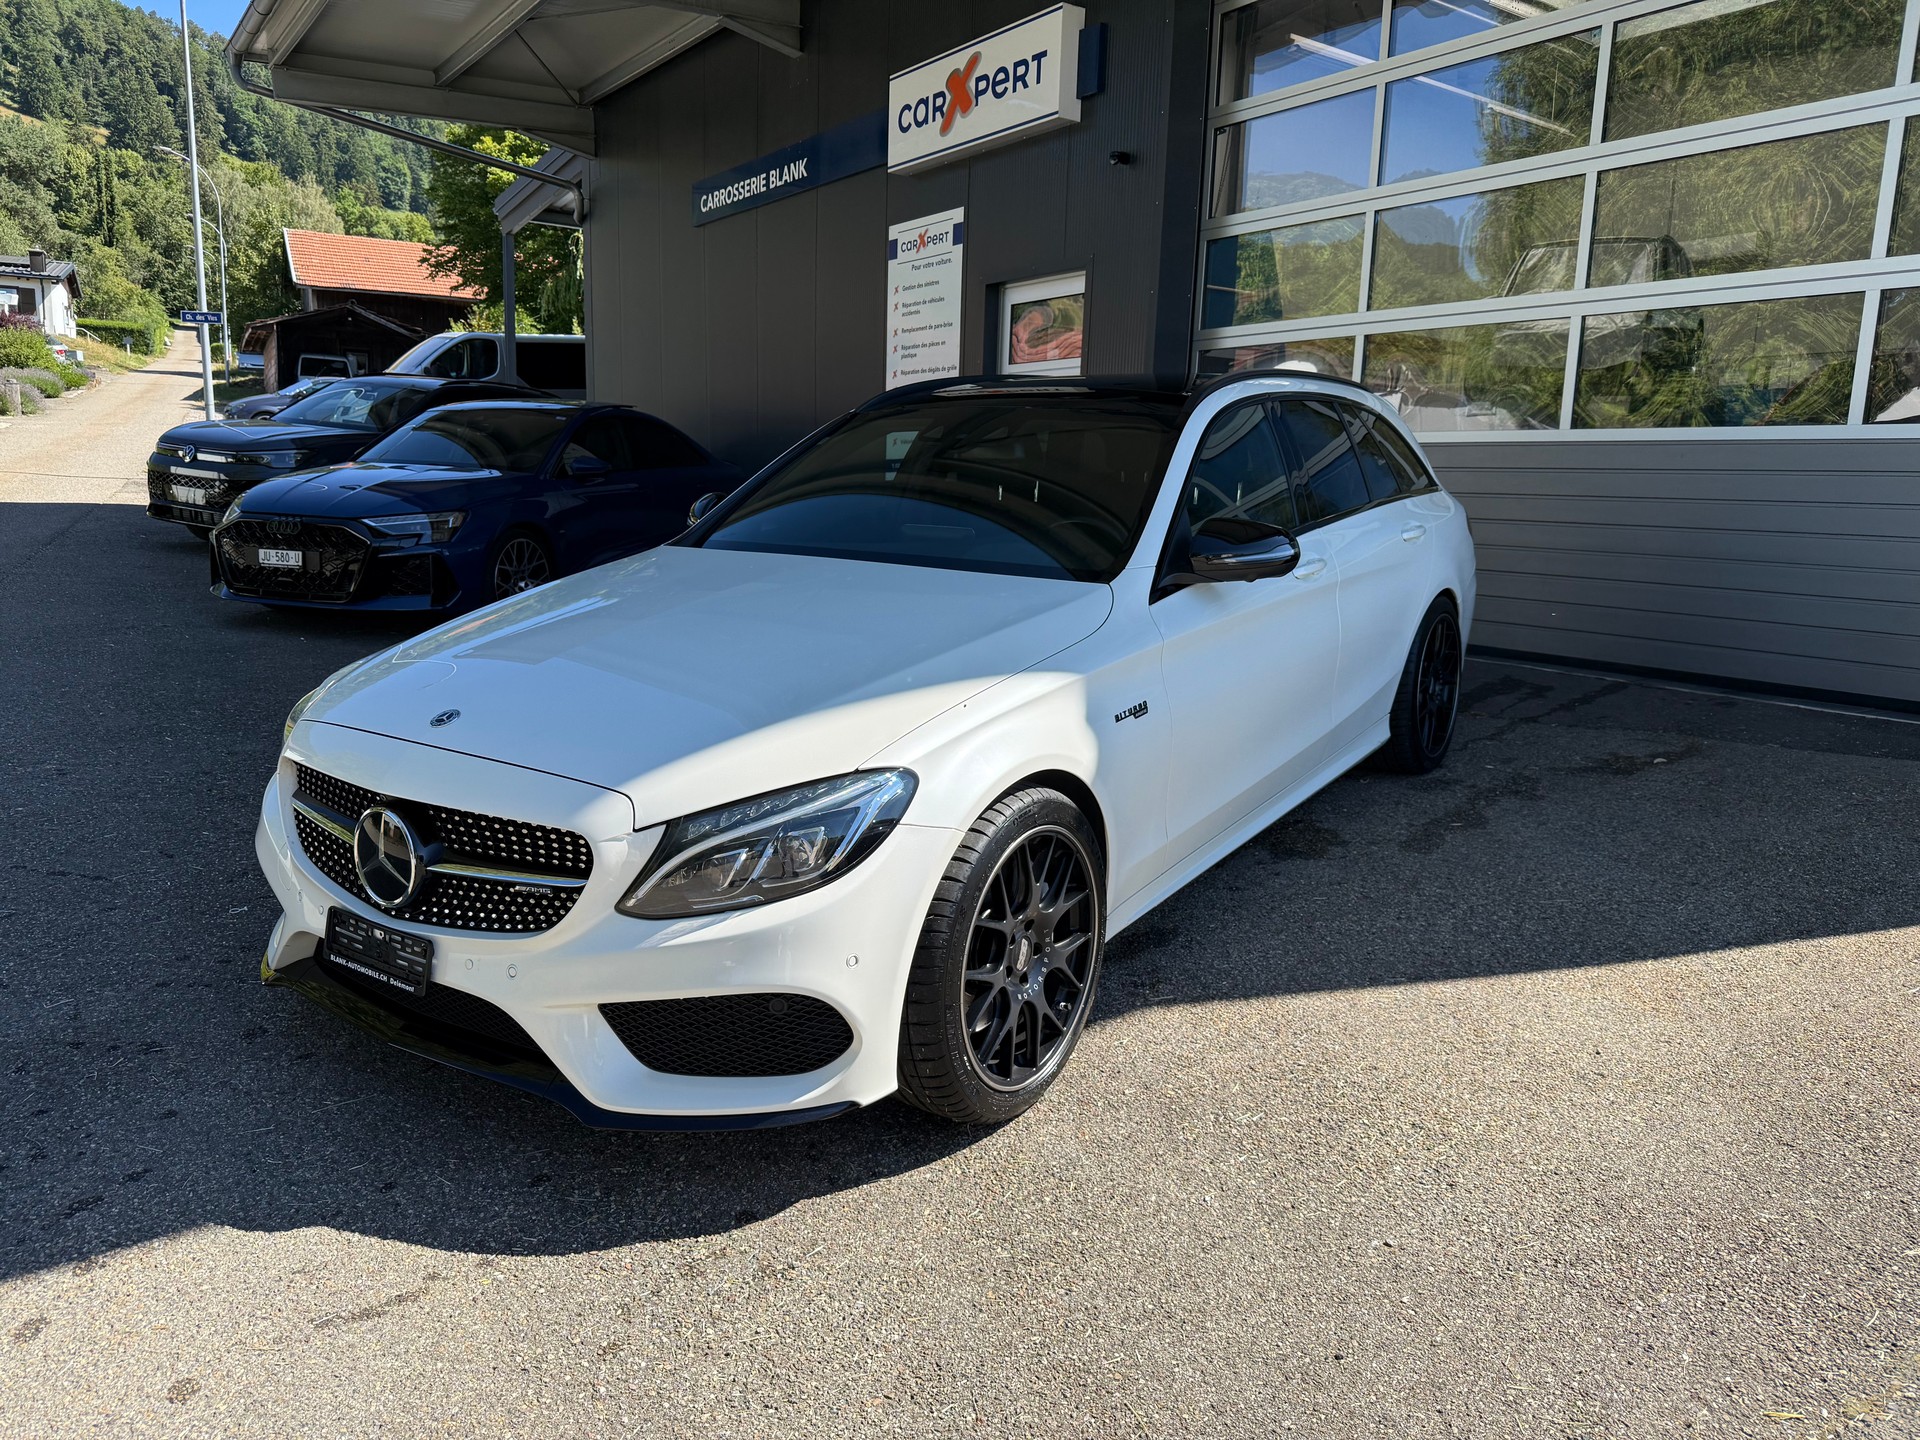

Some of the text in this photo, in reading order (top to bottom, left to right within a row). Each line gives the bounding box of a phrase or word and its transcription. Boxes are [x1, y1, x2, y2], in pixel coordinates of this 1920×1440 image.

[700, 158, 809, 213] CARROSSERIE BLANK
[922, 261, 935, 269] votre
[902, 300, 921, 309] Réparation
[902, 325, 928, 334] Remplacement
[901, 343, 921, 351] Réparation
[900, 368, 920, 376] Réparation
[330, 954, 388, 982] BLANK-AUTOMOBILE.CH
